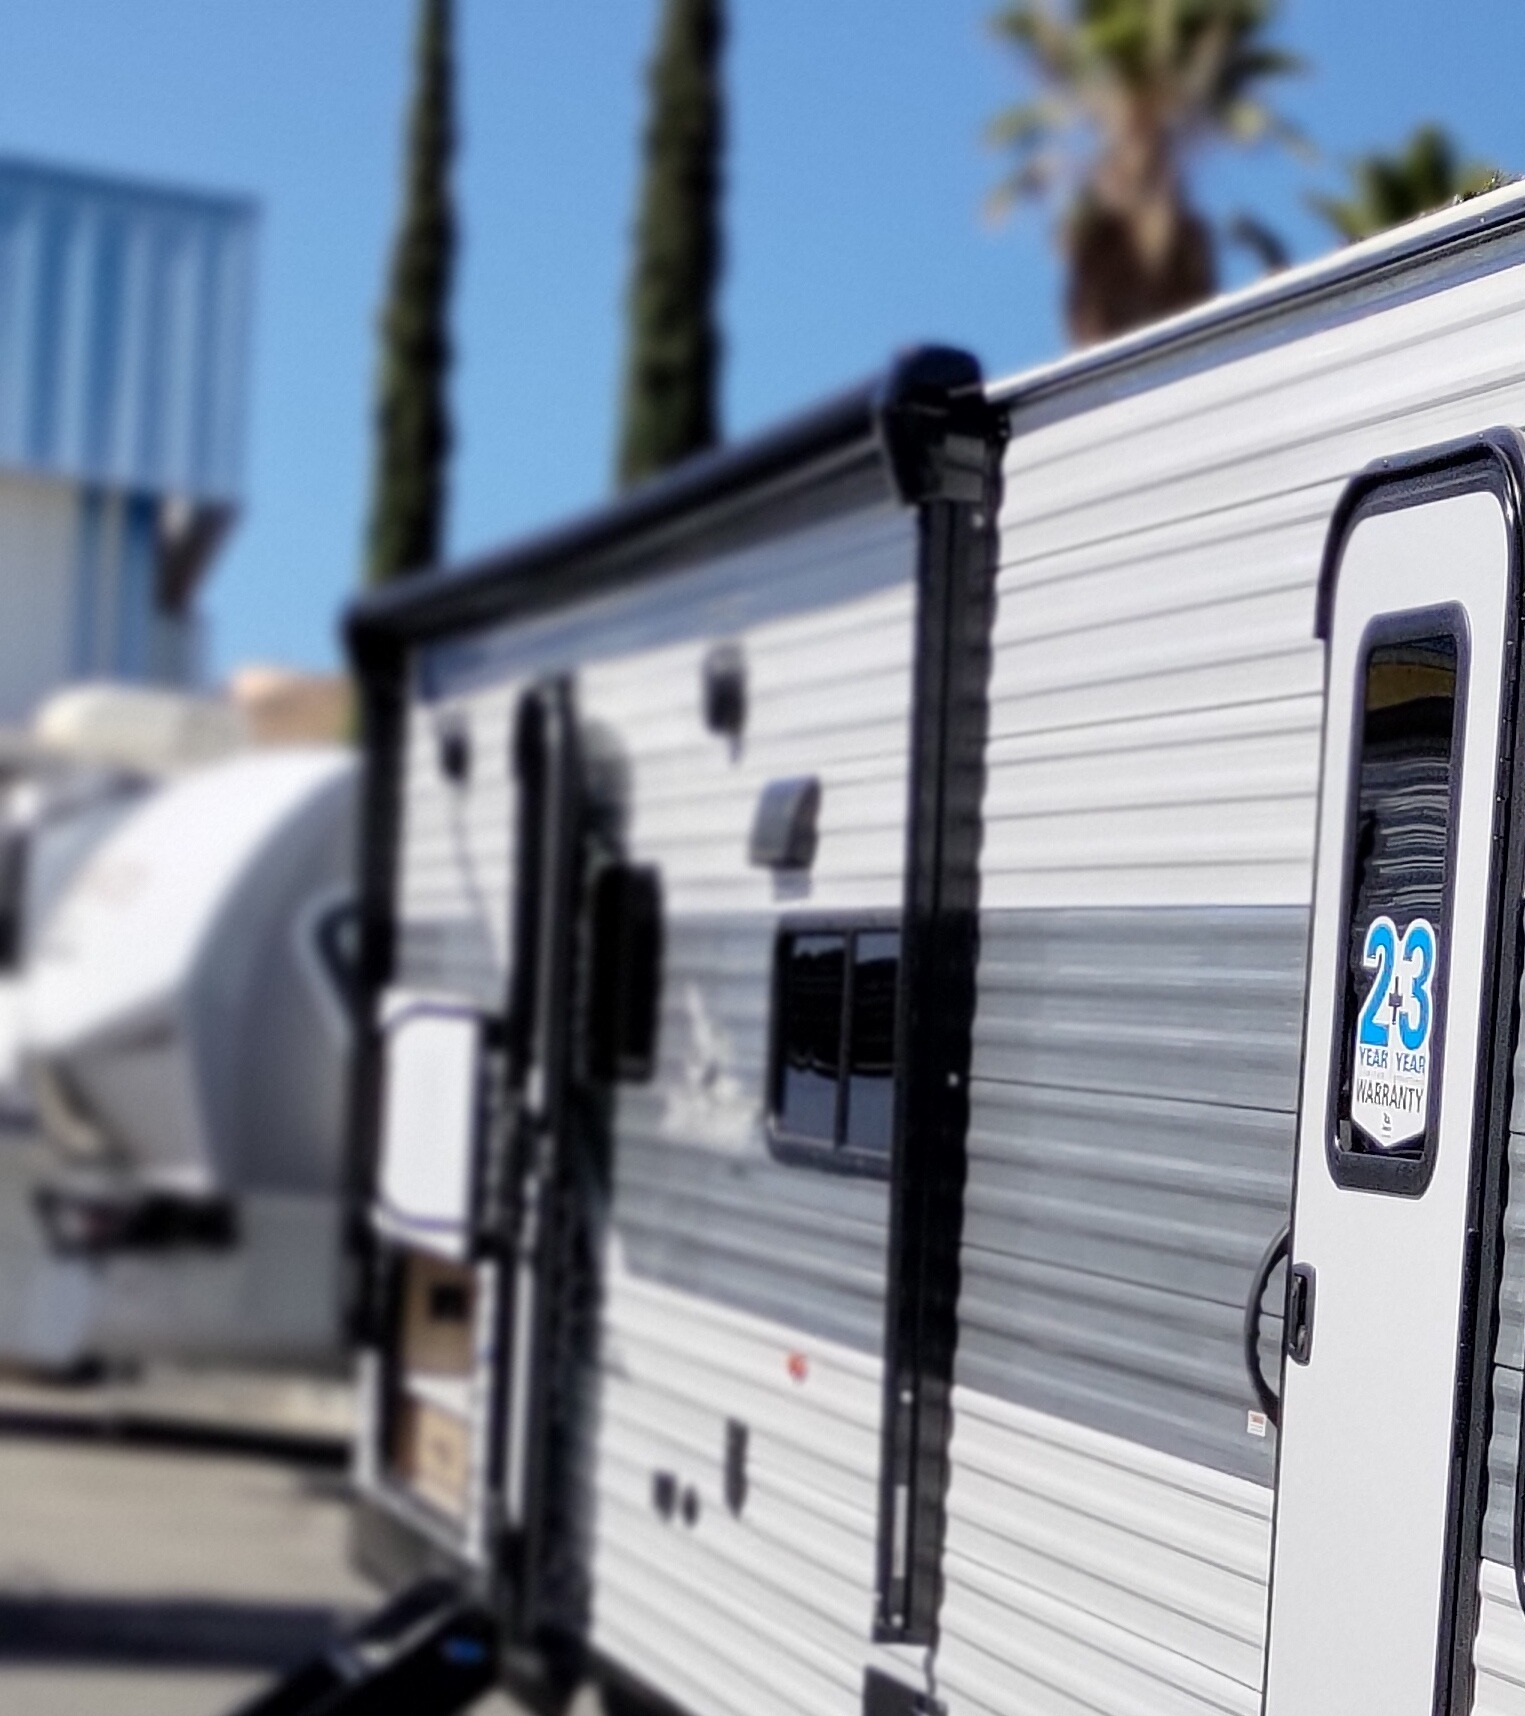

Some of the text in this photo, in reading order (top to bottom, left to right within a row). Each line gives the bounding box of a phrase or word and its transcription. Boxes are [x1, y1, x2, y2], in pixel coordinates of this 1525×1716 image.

[1358, 1046, 1426, 1074] YEAR YEAR
[1356, 1078, 1424, 1113] WARRANTY
